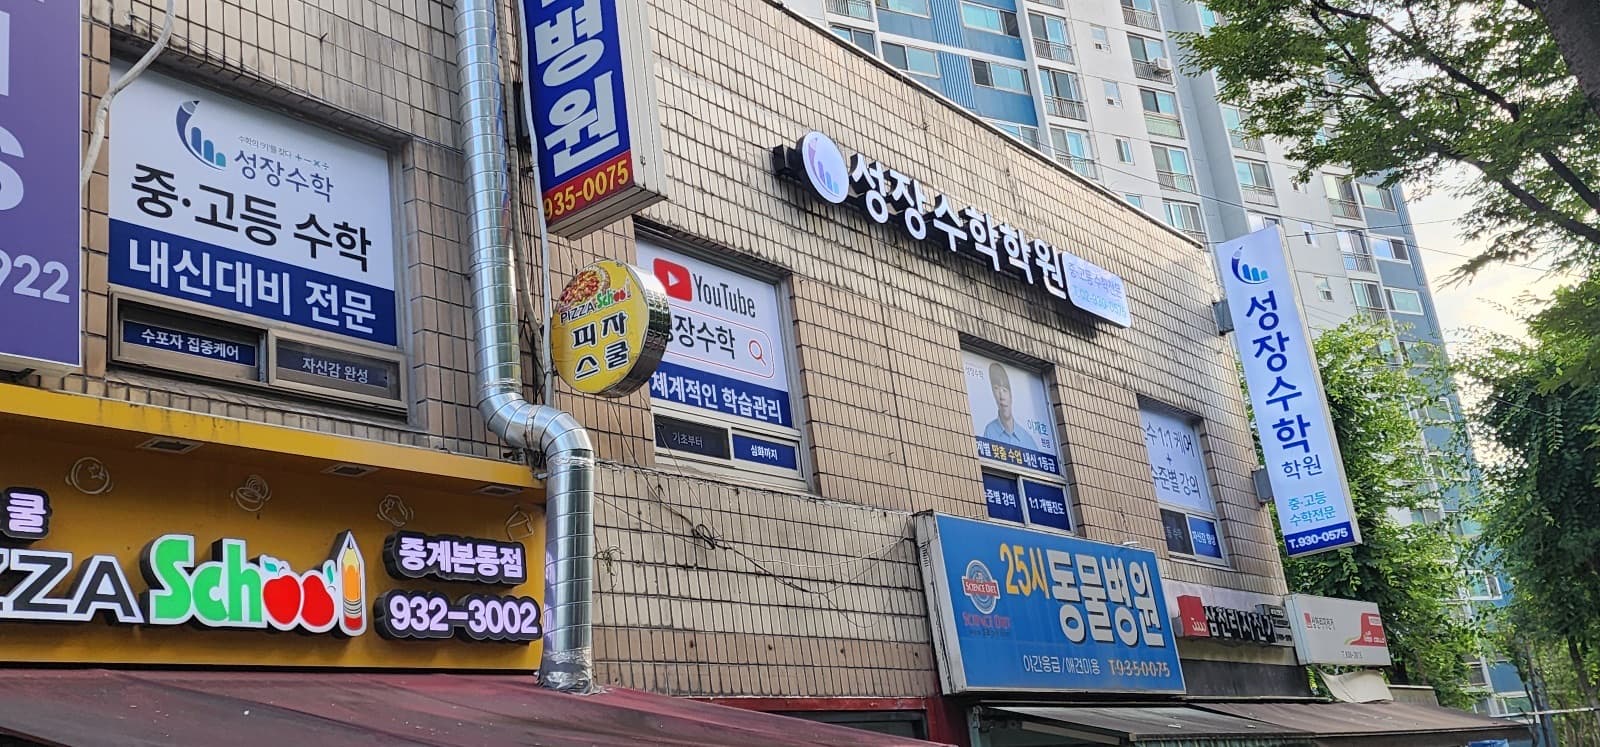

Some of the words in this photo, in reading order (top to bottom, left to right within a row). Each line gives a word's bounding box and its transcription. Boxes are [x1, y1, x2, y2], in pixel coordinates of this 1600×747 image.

[534, 0, 620, 177] 병원
[233, 150, 334, 203] 성장수학
[544, 159, 630, 220] 935-0075
[293, 212, 373, 274] 수학
[850, 153, 1067, 300] 성장수학학원
[128, 238, 292, 317] 내신대비
[304, 279, 377, 335] 전문
[692, 272, 756, 319] YouTube
[560, 302, 596, 325] PIZZA
[572, 312, 628, 348] 피자
[140, 327, 184, 350] 수포자
[186, 336, 240, 361] 집중케어
[668, 313, 736, 360] 장수학
[302, 354, 342, 378] 자신감
[343, 365, 369, 385] 완성
[575, 341, 630, 380] 스쿨
[1245, 290, 1312, 455] 성장수학
[650, 370, 718, 409] 체계적인
[721, 387, 783, 425] 학습관리
[672, 431, 703, 449] 기초부터
[750, 443, 779, 461] 심화까지
[1180, 472, 1202, 499] 강의
[1281, 454, 1323, 481] 학원
[6, 492, 47, 533] 쿨
[1289, 505, 1337, 527] 수학전문
[398, 537, 524, 579] 중계본동점
[1288, 527, 1349, 550] T.930-0575
[0, 548, 145, 623] ZA
[999, 543, 1050, 600] 25시
[1046, 548, 1166, 648] 동물병원
[388, 595, 539, 636] 932-3002
